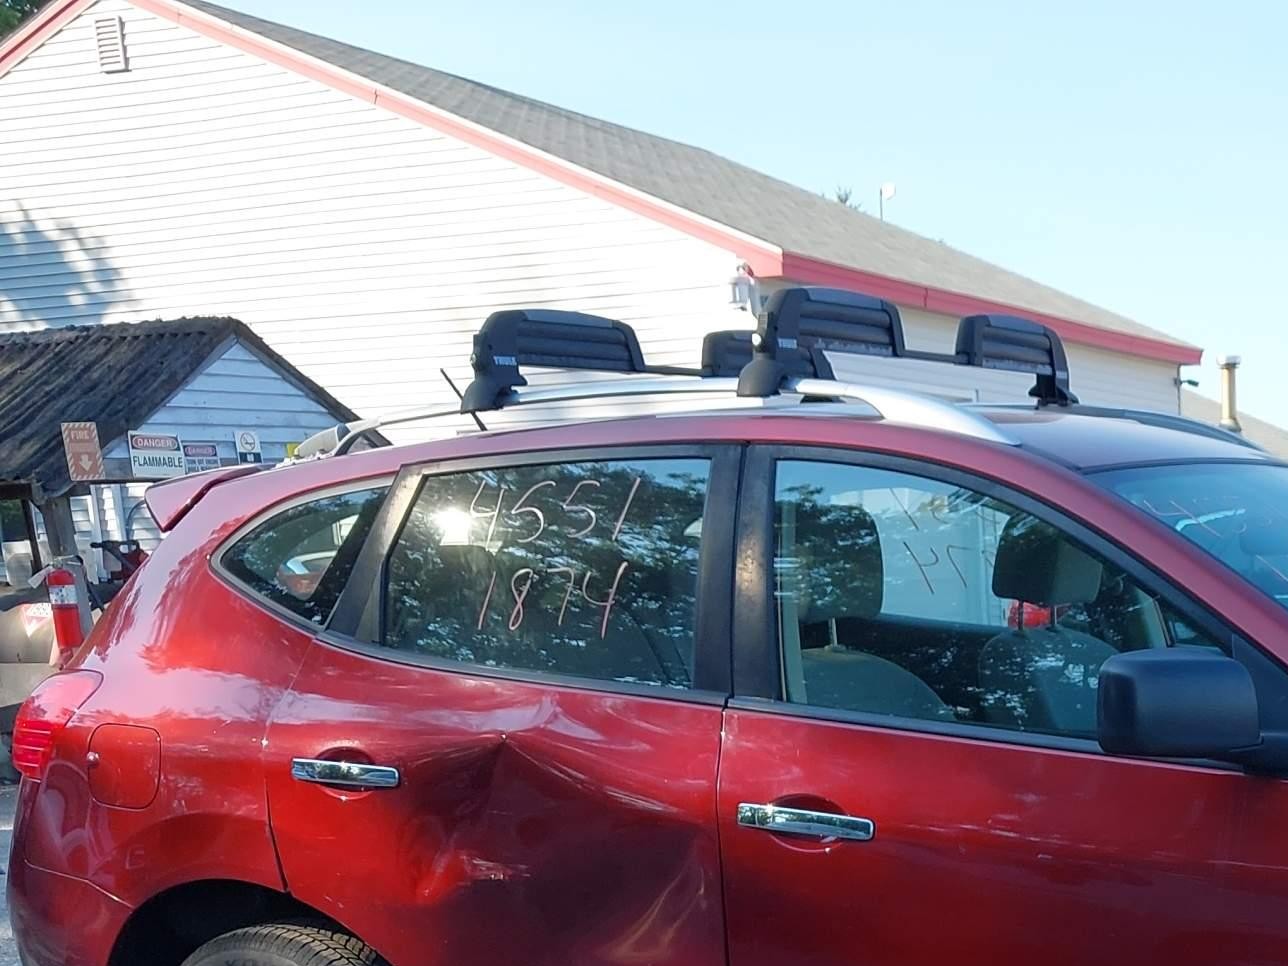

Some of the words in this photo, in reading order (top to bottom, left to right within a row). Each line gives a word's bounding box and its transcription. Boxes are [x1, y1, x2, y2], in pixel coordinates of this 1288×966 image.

[71, 430, 90, 440] FIRE
[138, 438, 173, 449] DANGER
[133, 455, 183, 468] FLAMMABLE
[470, 476, 641, 553] 4551
[478, 561, 629, 640] 1874
